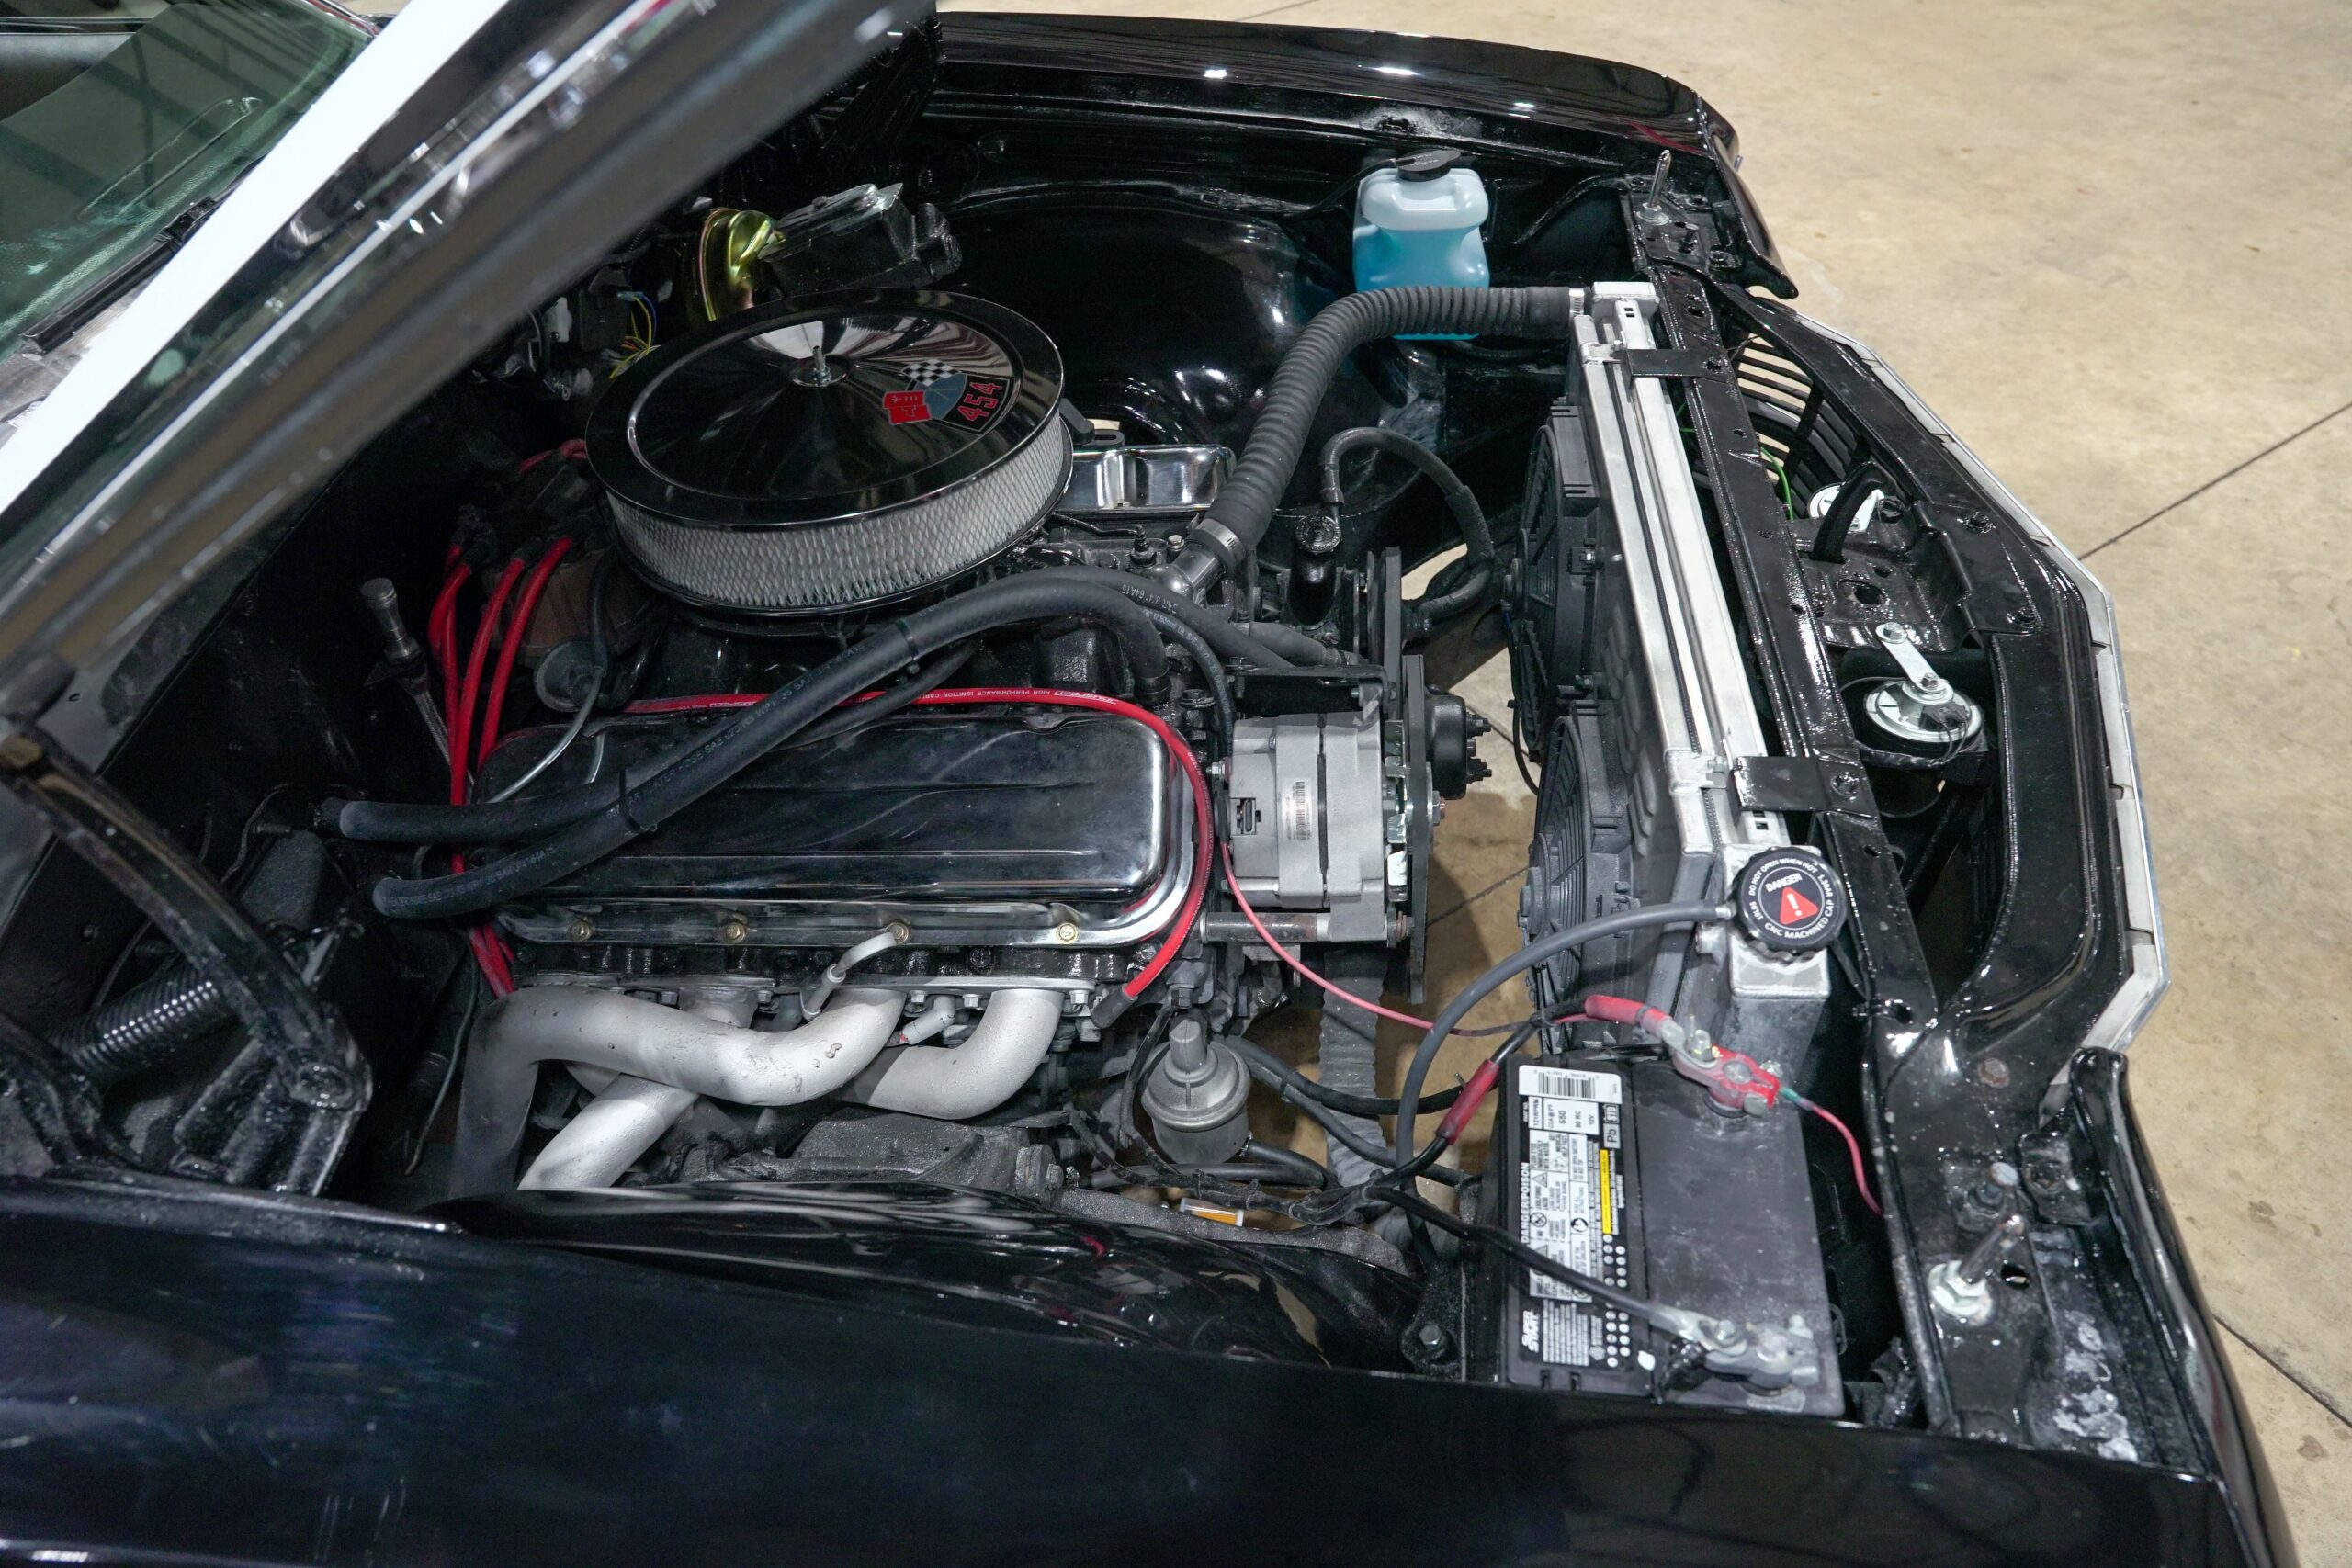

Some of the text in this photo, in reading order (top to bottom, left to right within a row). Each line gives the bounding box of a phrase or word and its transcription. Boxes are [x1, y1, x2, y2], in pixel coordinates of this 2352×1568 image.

[957, 382, 1002, 422] 454
[943, 691, 974, 699] IGNITION
[1748, 857, 1819, 896] DO NOT OPEN WHEN HOT
[1765, 873, 1803, 892] DANGER
[1764, 899, 1836, 940] CNC MACHINED CAP
[1558, 1110, 1567, 1125] 550
[1606, 1128, 1617, 1144] Pb
[1521, 1162, 1530, 1244] DANGER/POISON
